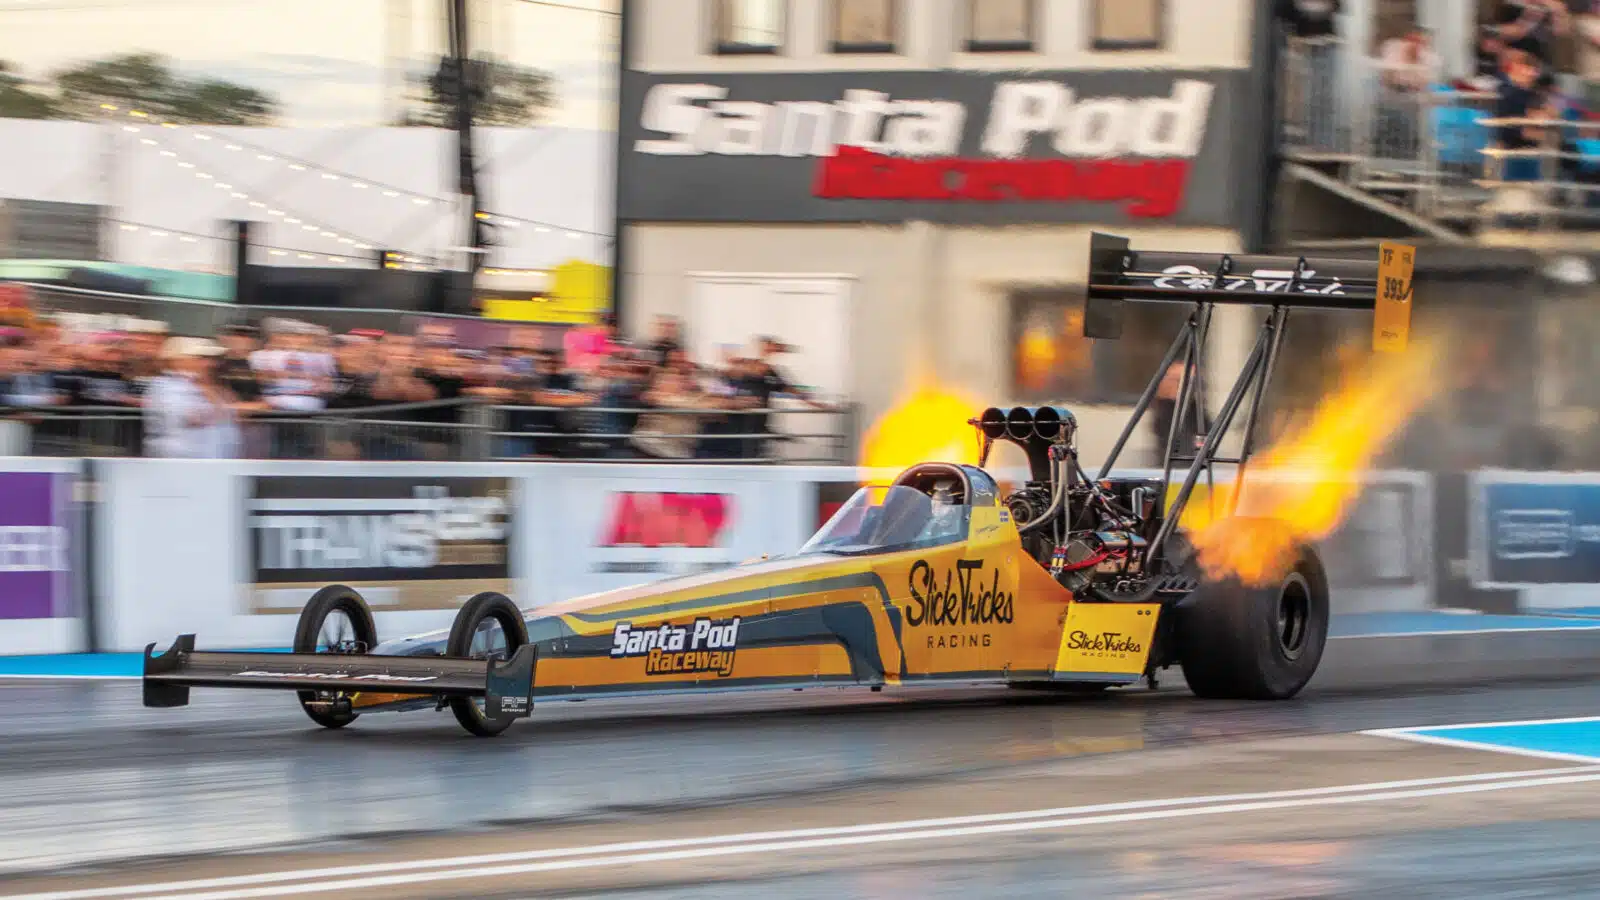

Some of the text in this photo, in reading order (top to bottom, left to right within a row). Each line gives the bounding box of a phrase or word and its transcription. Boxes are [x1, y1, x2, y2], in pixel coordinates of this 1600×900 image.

[634, 80, 1216, 158] Santa Pod
[813, 145, 1190, 218] Raceway
[609, 617, 741, 656] Santa Pod
[927, 634, 992, 649] RACING
[646, 648, 735, 676] Raceway
